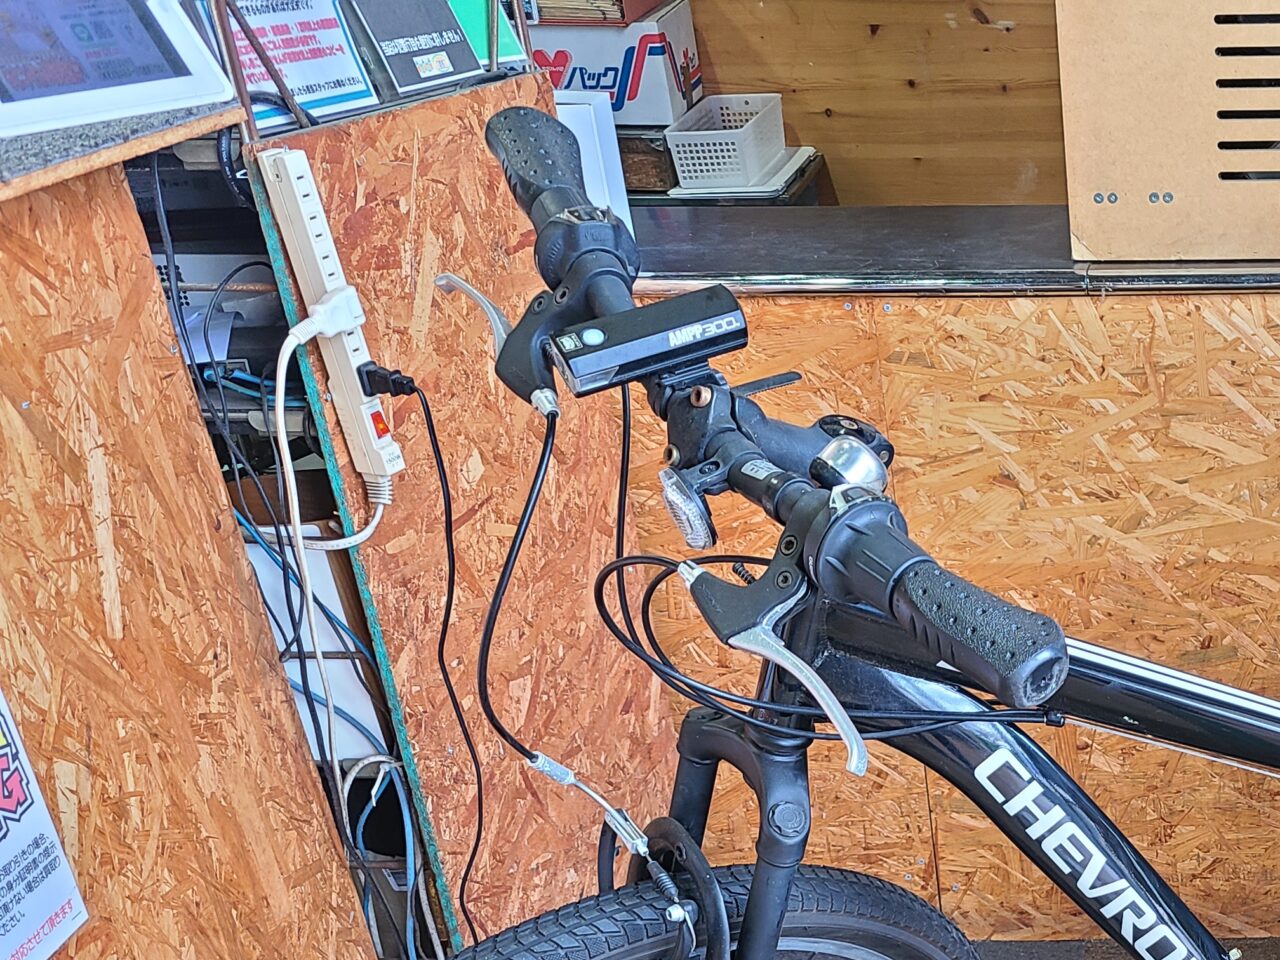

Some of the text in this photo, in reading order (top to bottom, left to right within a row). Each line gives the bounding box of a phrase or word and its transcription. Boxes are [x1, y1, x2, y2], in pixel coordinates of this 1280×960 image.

[564, 67, 619, 90] パック
[0, 842, 58, 900] の身分証明書の提示
